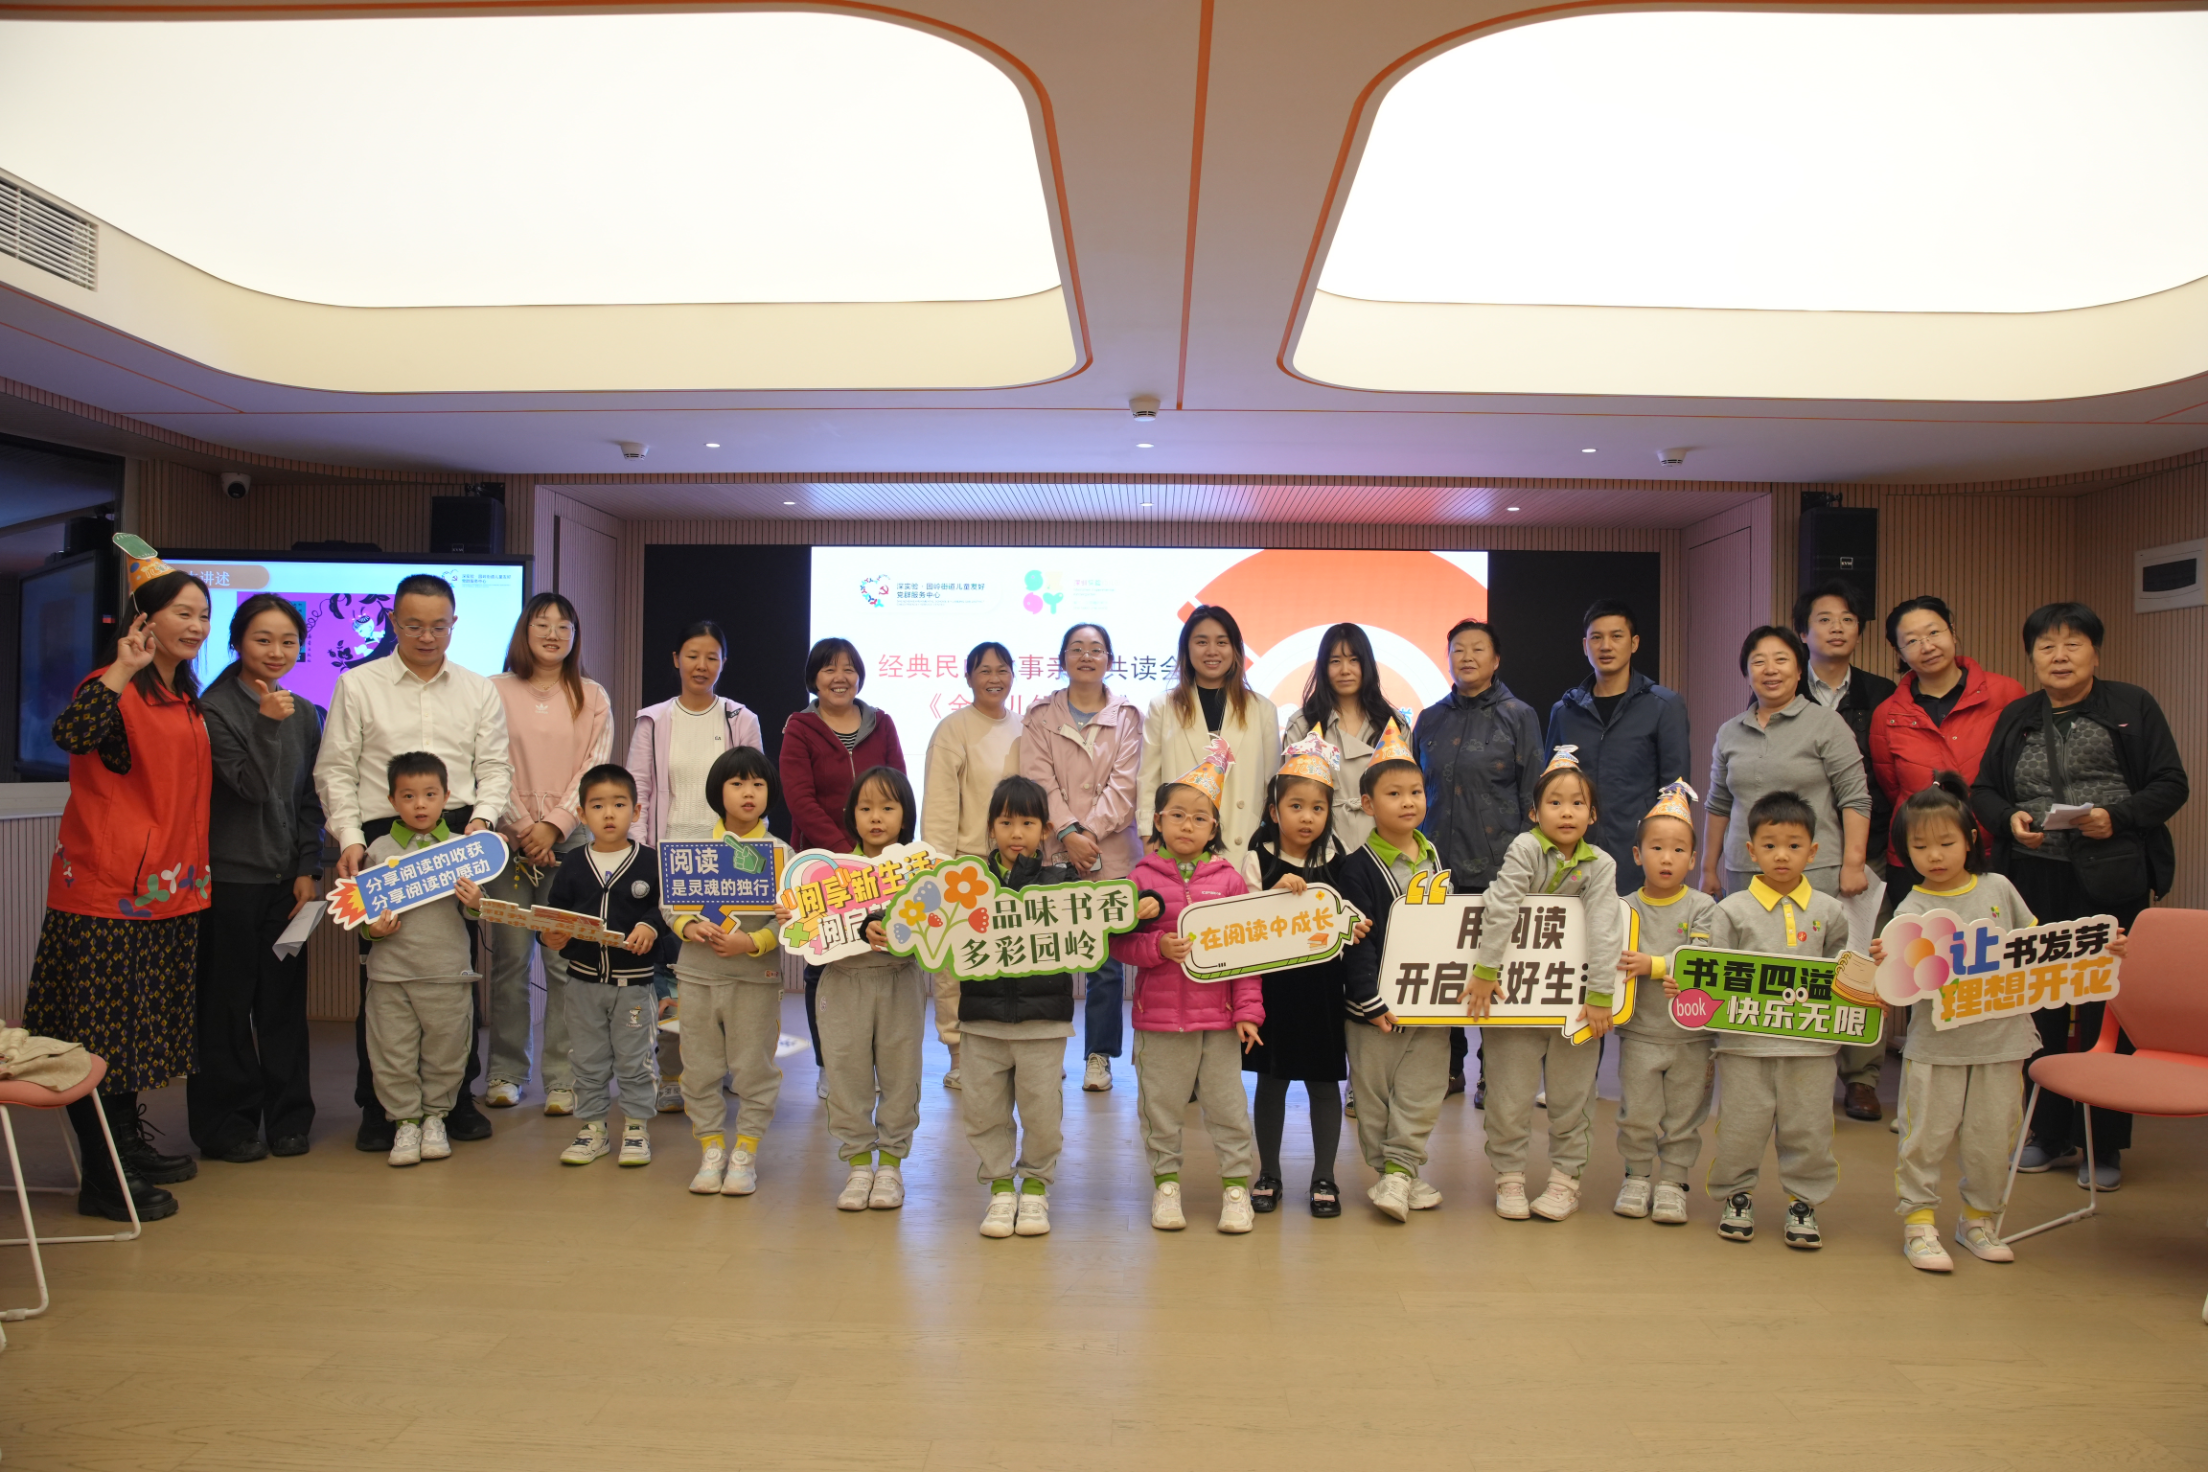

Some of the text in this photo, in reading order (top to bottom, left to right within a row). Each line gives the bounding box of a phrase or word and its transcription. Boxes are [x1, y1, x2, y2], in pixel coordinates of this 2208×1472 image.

[366, 840, 485, 895] 分享阅读的收获
[669, 847, 719, 875] 阅读
[371, 858, 491, 912] 分享阅读的感动
[671, 879, 770, 898] 是灵魂的独行
[992, 889, 1130, 930] 品味书香
[1200, 906, 1335, 951] 在阅读中成长
[961, 929, 1097, 971] 多彩园岭
[1683, 957, 1836, 1001] 书香四溢
[1940, 955, 2114, 1021] 理想开花
[1676, 997, 1707, 1017] book
[1727, 995, 1867, 1037] 快乐无限
